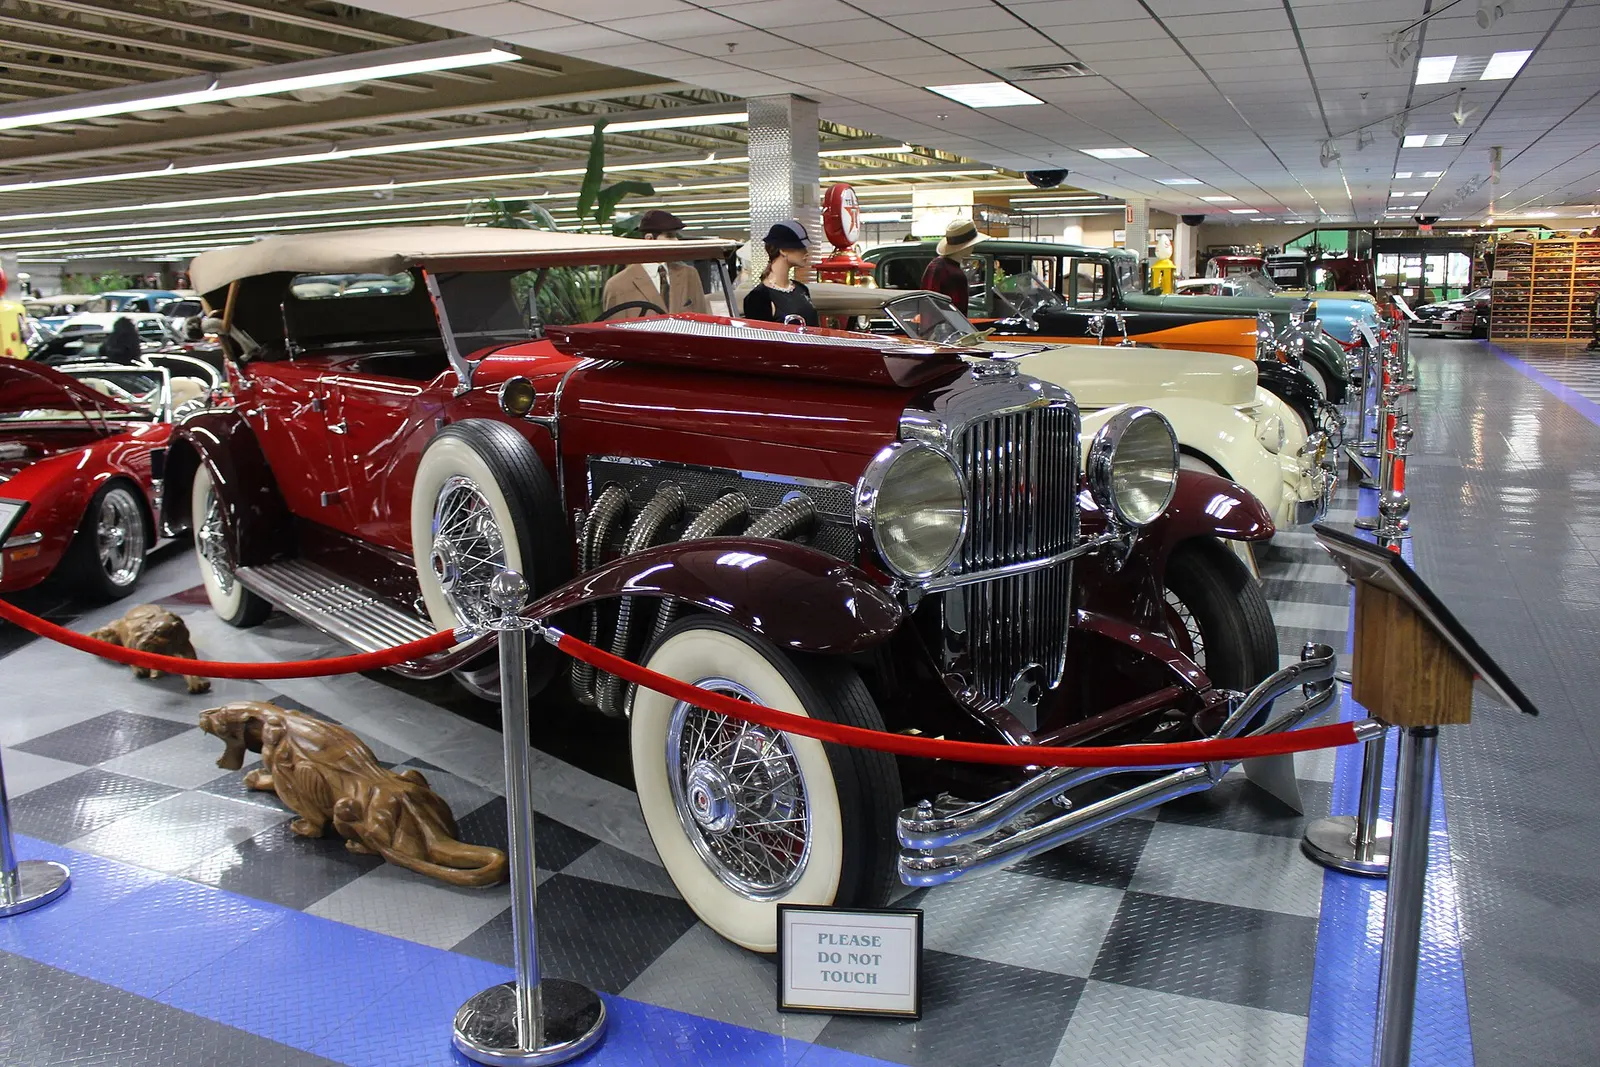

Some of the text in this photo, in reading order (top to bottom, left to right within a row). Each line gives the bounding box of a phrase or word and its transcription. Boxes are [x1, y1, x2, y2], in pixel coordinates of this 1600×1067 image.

[818, 933, 882, 948] PLEASE
[818, 951, 882, 966] DO NOT
[820, 970, 877, 985] TOUCH
